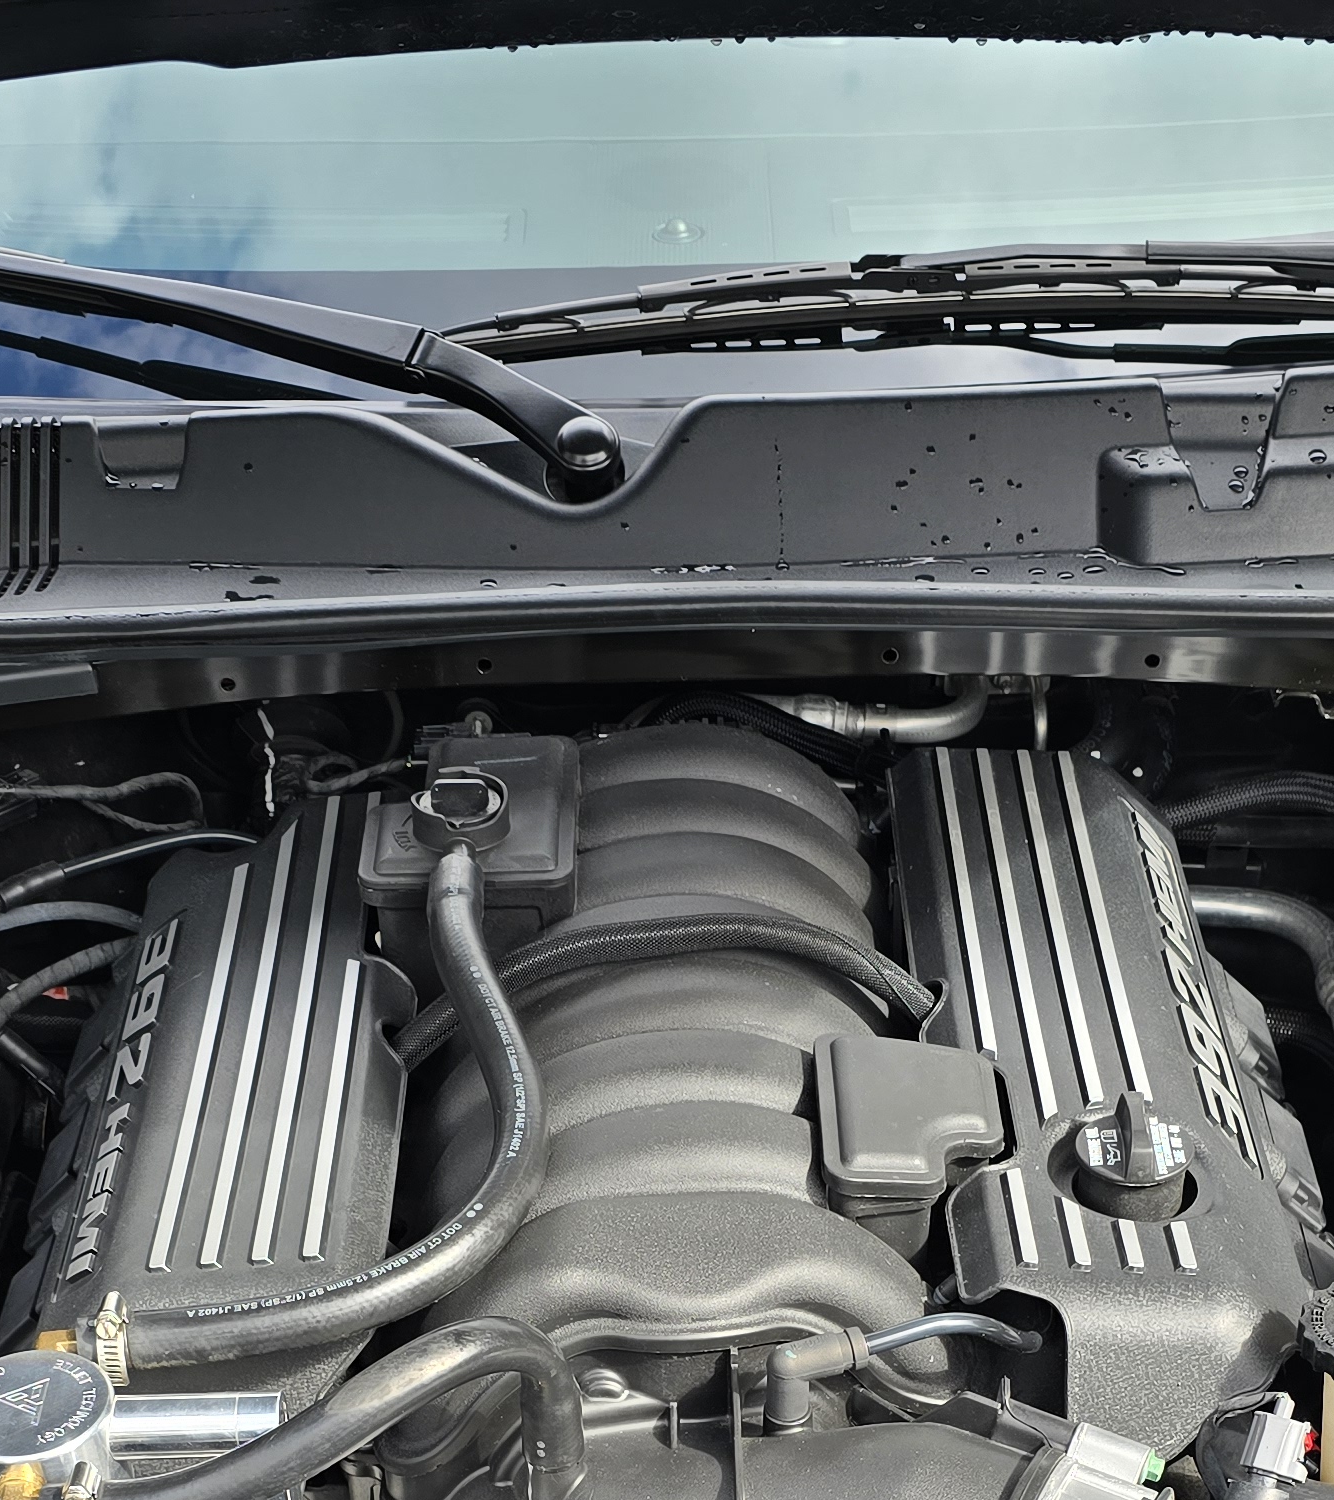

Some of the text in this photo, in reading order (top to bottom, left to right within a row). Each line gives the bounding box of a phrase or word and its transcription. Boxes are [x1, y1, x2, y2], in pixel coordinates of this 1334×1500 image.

[1131, 808, 1257, 1171] 392 HEMI
[495, 1020, 512, 1046] BRAKE
[66, 918, 179, 1281] 392 HEMI
[514, 1111, 526, 1129] SAE
[506, 1149, 517, 1158] A
[440, 1222, 464, 1241] DOT
[428, 1236, 443, 1250] CT
[402, 1245, 428, 1263] AIR
[369, 1255, 409, 1278] BRAKE
[326, 1273, 367, 1293] 12.5mm
[308, 1287, 325, 1299] SP
[186, 1309, 196, 1318] A
[197, 1305, 232, 1317] J1402
[234, 1302, 258, 1314] SAE
